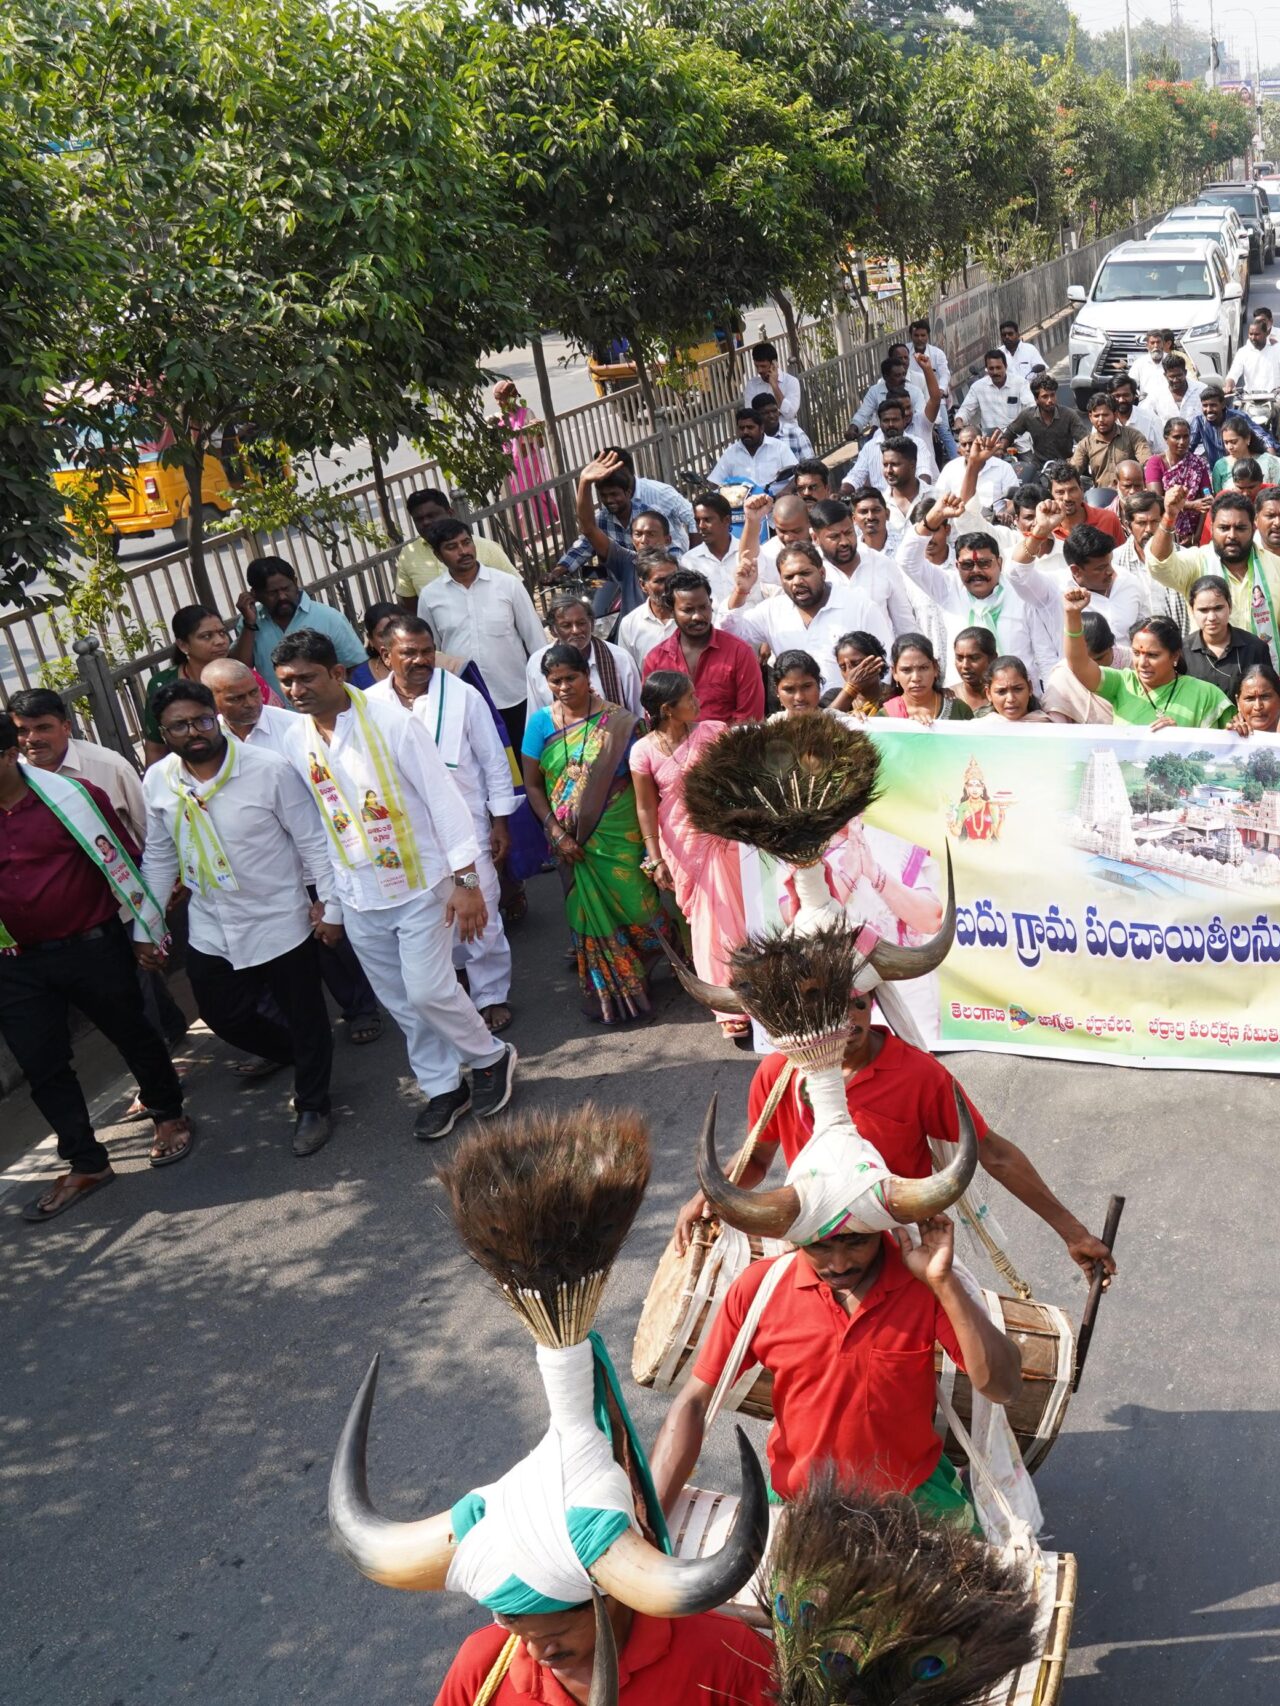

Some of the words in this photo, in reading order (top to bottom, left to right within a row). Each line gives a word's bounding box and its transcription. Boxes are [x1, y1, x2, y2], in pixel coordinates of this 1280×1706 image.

[955, 900, 1007, 947] ఐదు
[1012, 905, 1077, 967] గ్రామ
[951, 1003, 1005, 1021] తెలంగాణ
[1038, 1013, 1074, 1032] జాగృతి
[1149, 1018, 1186, 1040] భద్రాద్రి
